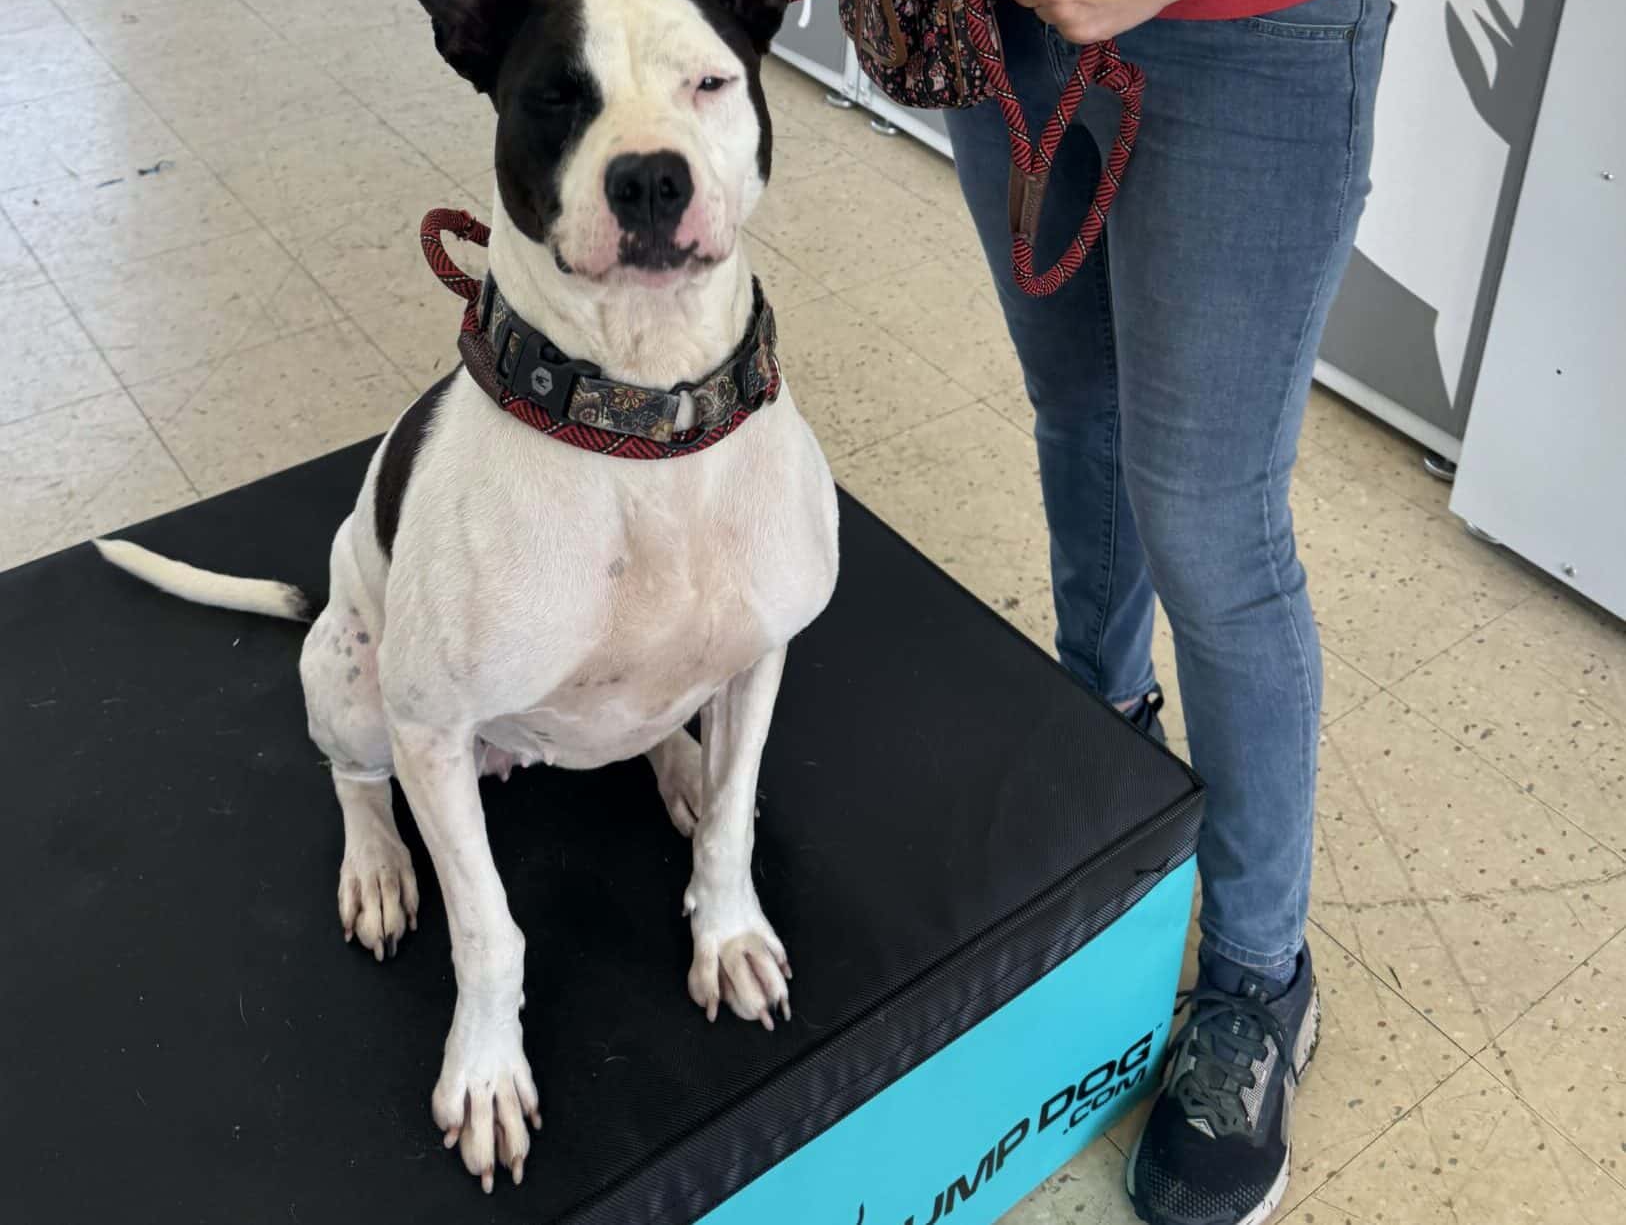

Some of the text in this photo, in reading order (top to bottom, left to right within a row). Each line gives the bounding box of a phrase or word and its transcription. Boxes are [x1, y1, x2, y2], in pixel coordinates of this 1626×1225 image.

[902, 1030, 1154, 1225] UMP DOG
[1063, 1064, 1148, 1135] .COM
